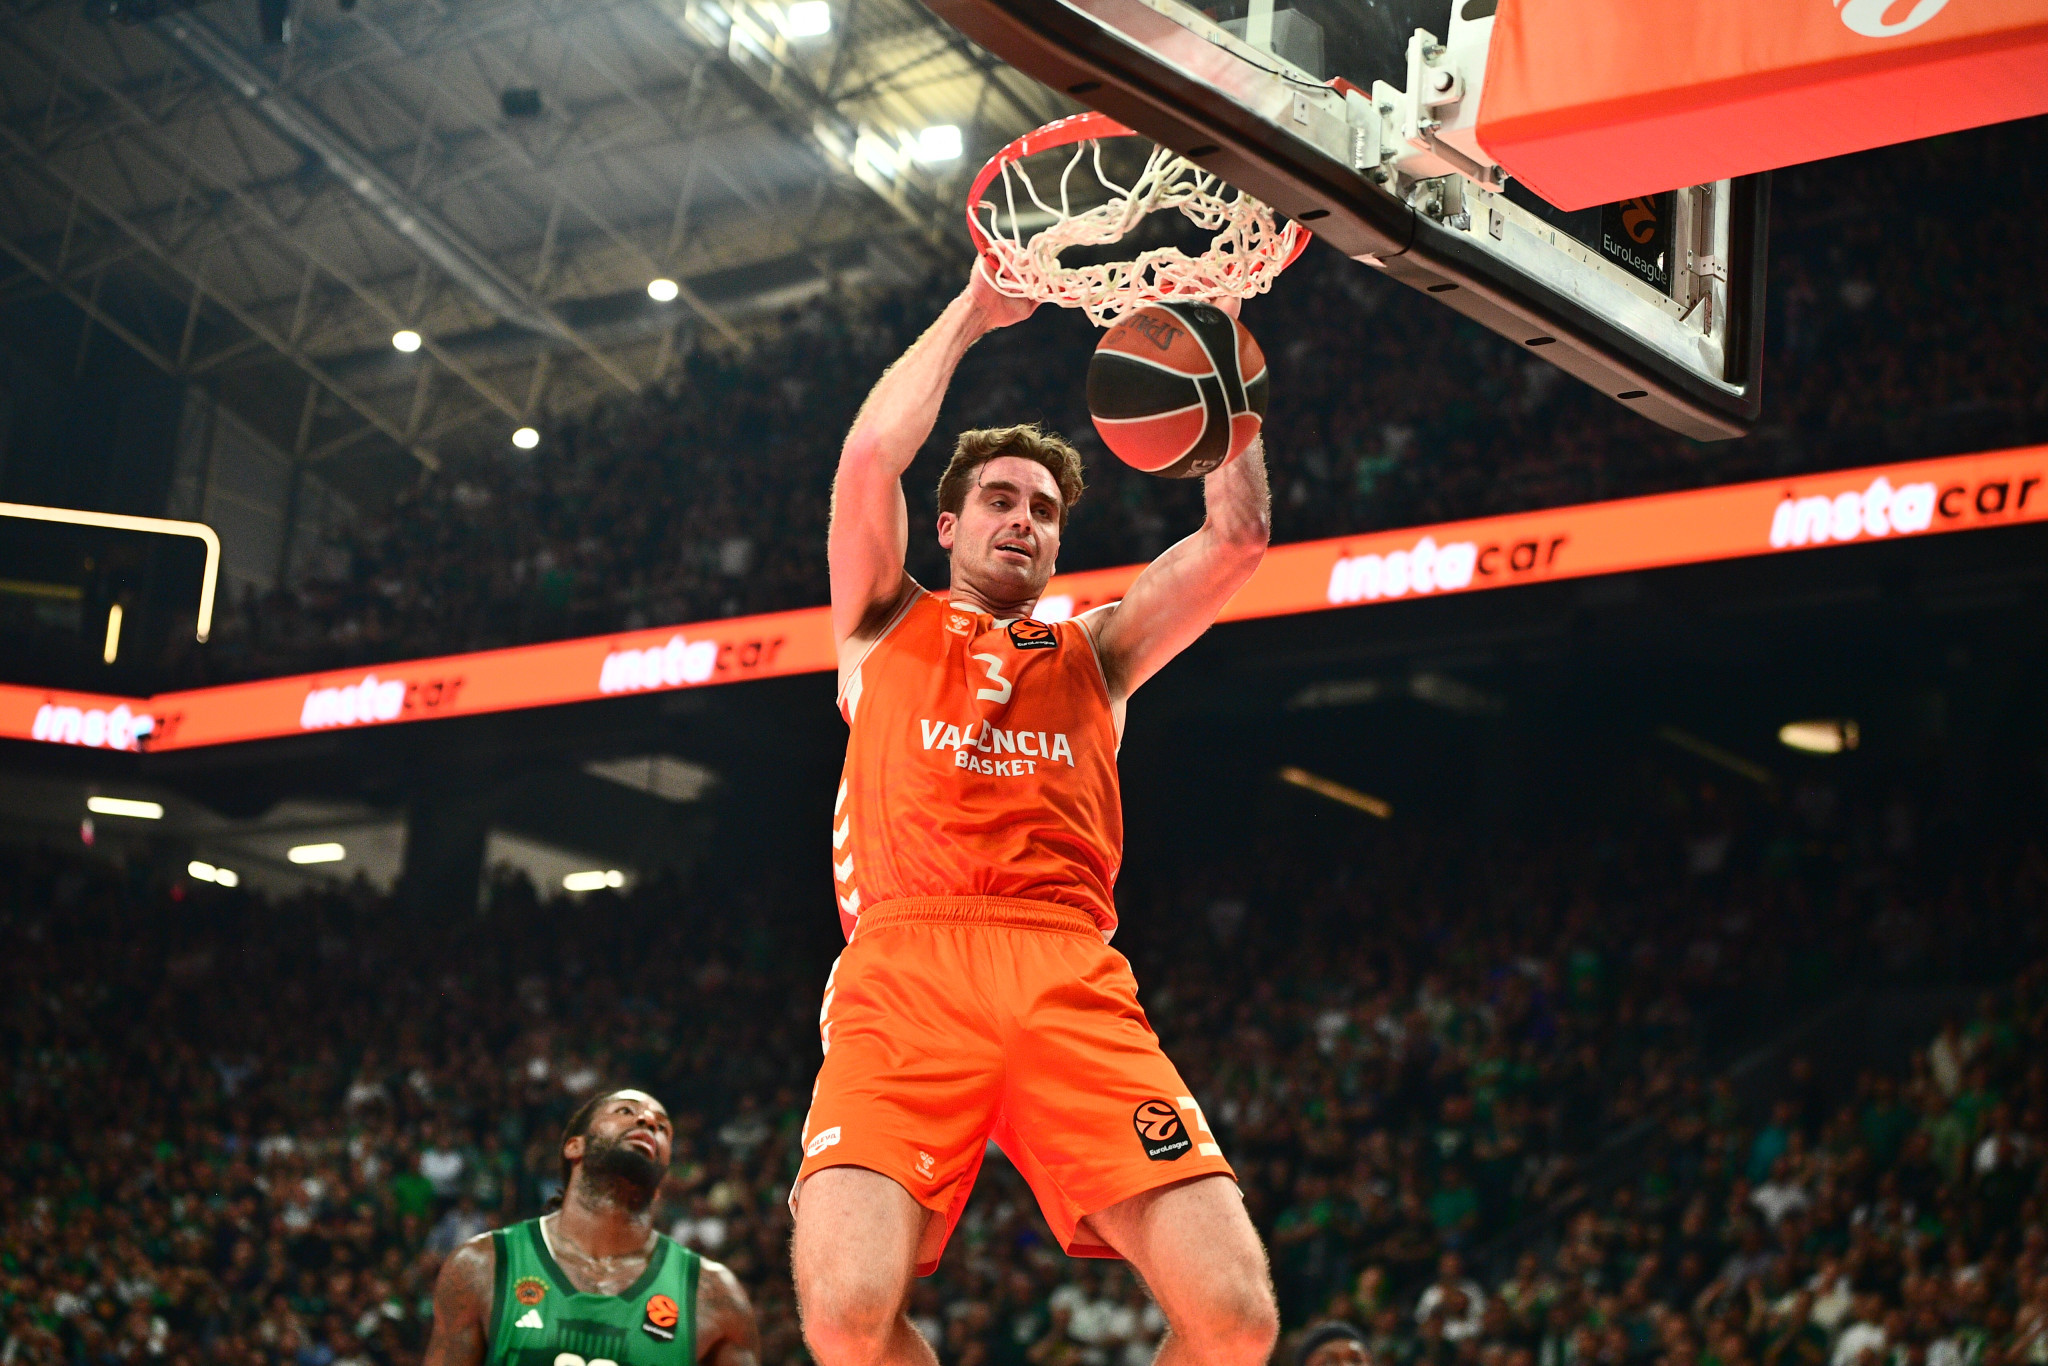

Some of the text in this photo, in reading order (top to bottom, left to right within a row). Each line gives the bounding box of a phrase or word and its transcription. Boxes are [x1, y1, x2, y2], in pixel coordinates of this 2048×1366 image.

[1603, 233, 1668, 285] EuroLeague
[972, 652, 1013, 705] 3
[920, 718, 1075, 768] VALENCIA
[954, 750, 1037, 777] BASKET
[1149, 1140, 1189, 1157] EuroLeague
